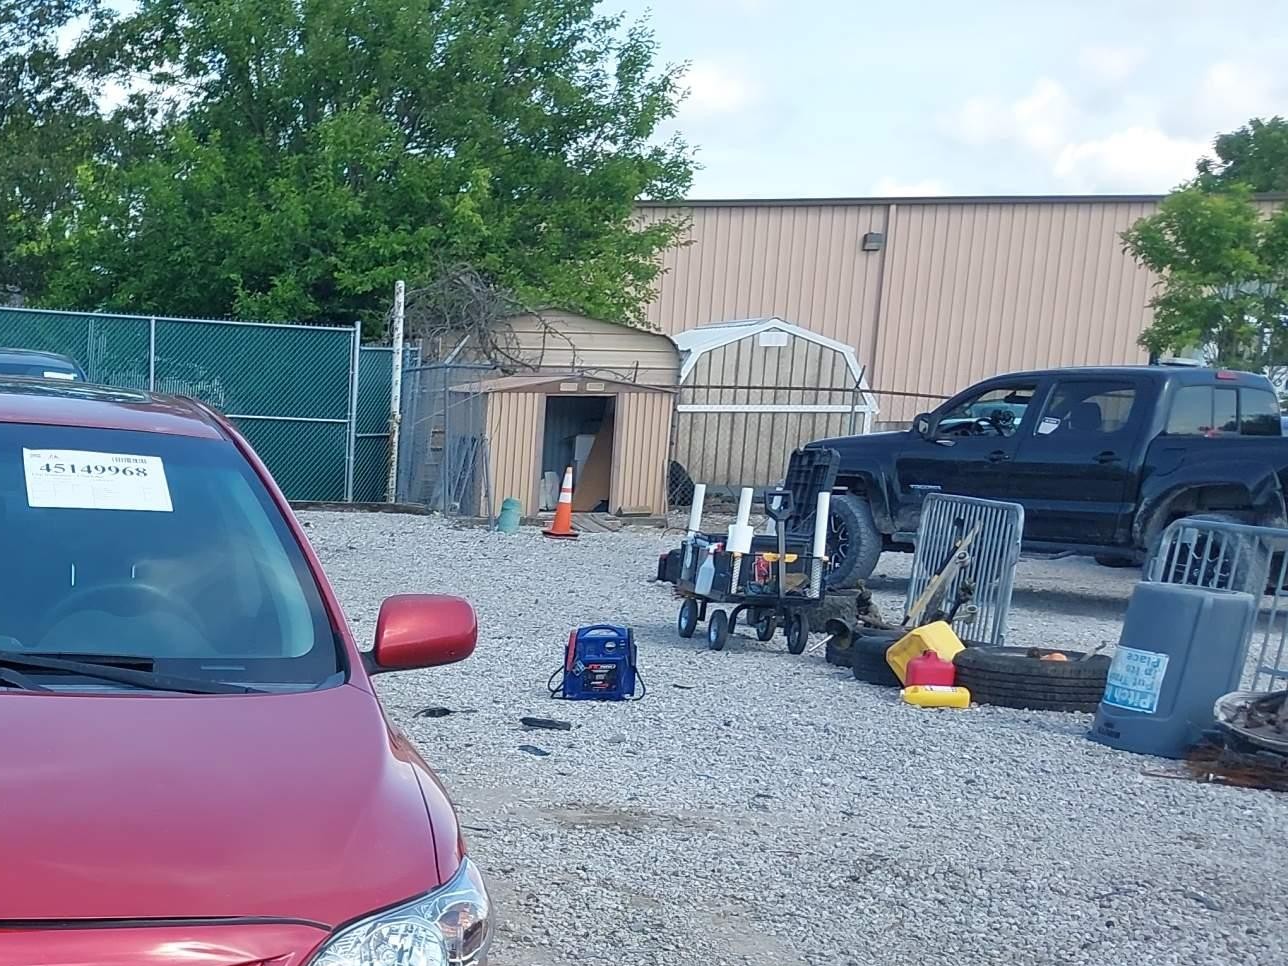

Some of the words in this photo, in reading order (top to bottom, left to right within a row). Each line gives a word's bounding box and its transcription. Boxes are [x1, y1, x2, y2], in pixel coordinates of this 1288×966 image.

[39, 463, 148, 477] 45149968
[1127, 652, 1161, 668] Place
[1114, 687, 1150, 708] Pitch
